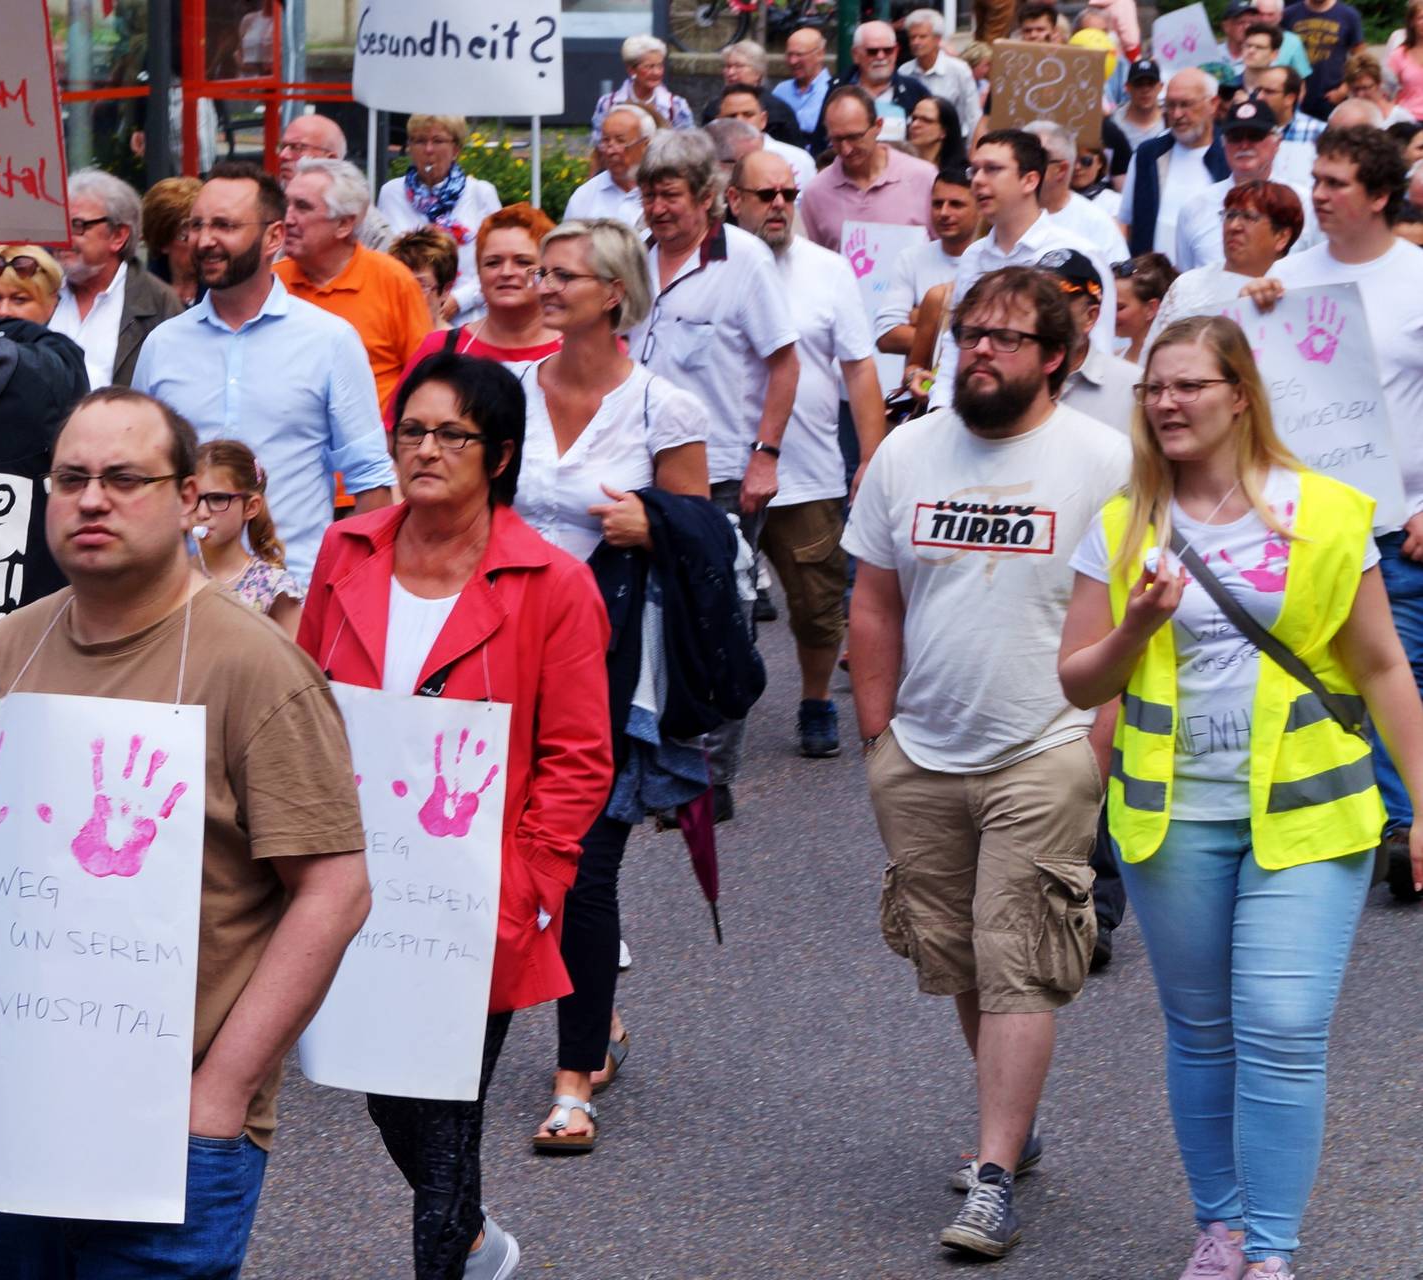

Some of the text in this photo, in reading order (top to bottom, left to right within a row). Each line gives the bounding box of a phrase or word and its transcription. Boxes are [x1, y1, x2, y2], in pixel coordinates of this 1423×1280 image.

[1267, 377, 1309, 402] EG
[930, 513, 1035, 546] TURBO
[364, 830, 409, 861] EG
